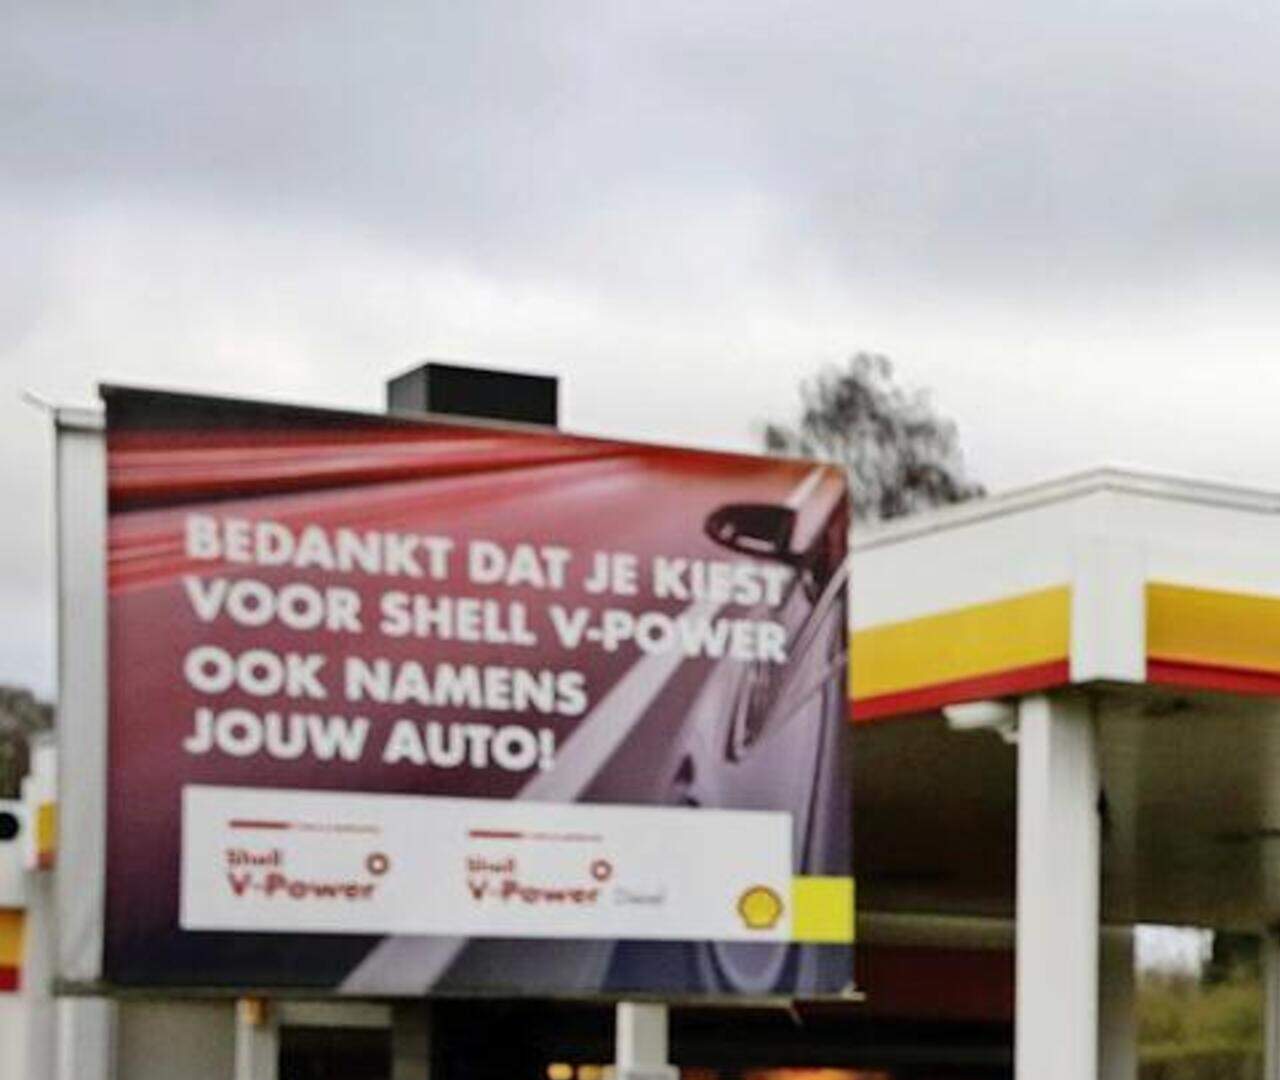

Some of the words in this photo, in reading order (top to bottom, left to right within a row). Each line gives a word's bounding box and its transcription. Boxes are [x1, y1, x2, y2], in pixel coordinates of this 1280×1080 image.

[184, 513, 453, 580] BEDANKT
[468, 540, 570, 589] DAT
[583, 552, 638, 597] JE
[653, 555, 793, 608] KIEST
[184, 575, 363, 633] VOOR
[379, 590, 537, 646] SHELL
[550, 604, 788, 665] V-POWER
[183, 645, 326, 699] OOK
[343, 656, 588, 716] NAMENS
[183, 706, 369, 762] JOUW
[382, 717, 557, 773] AUTO!
[227, 872, 375, 899] V-Power
[468, 880, 599, 904] V-Power
